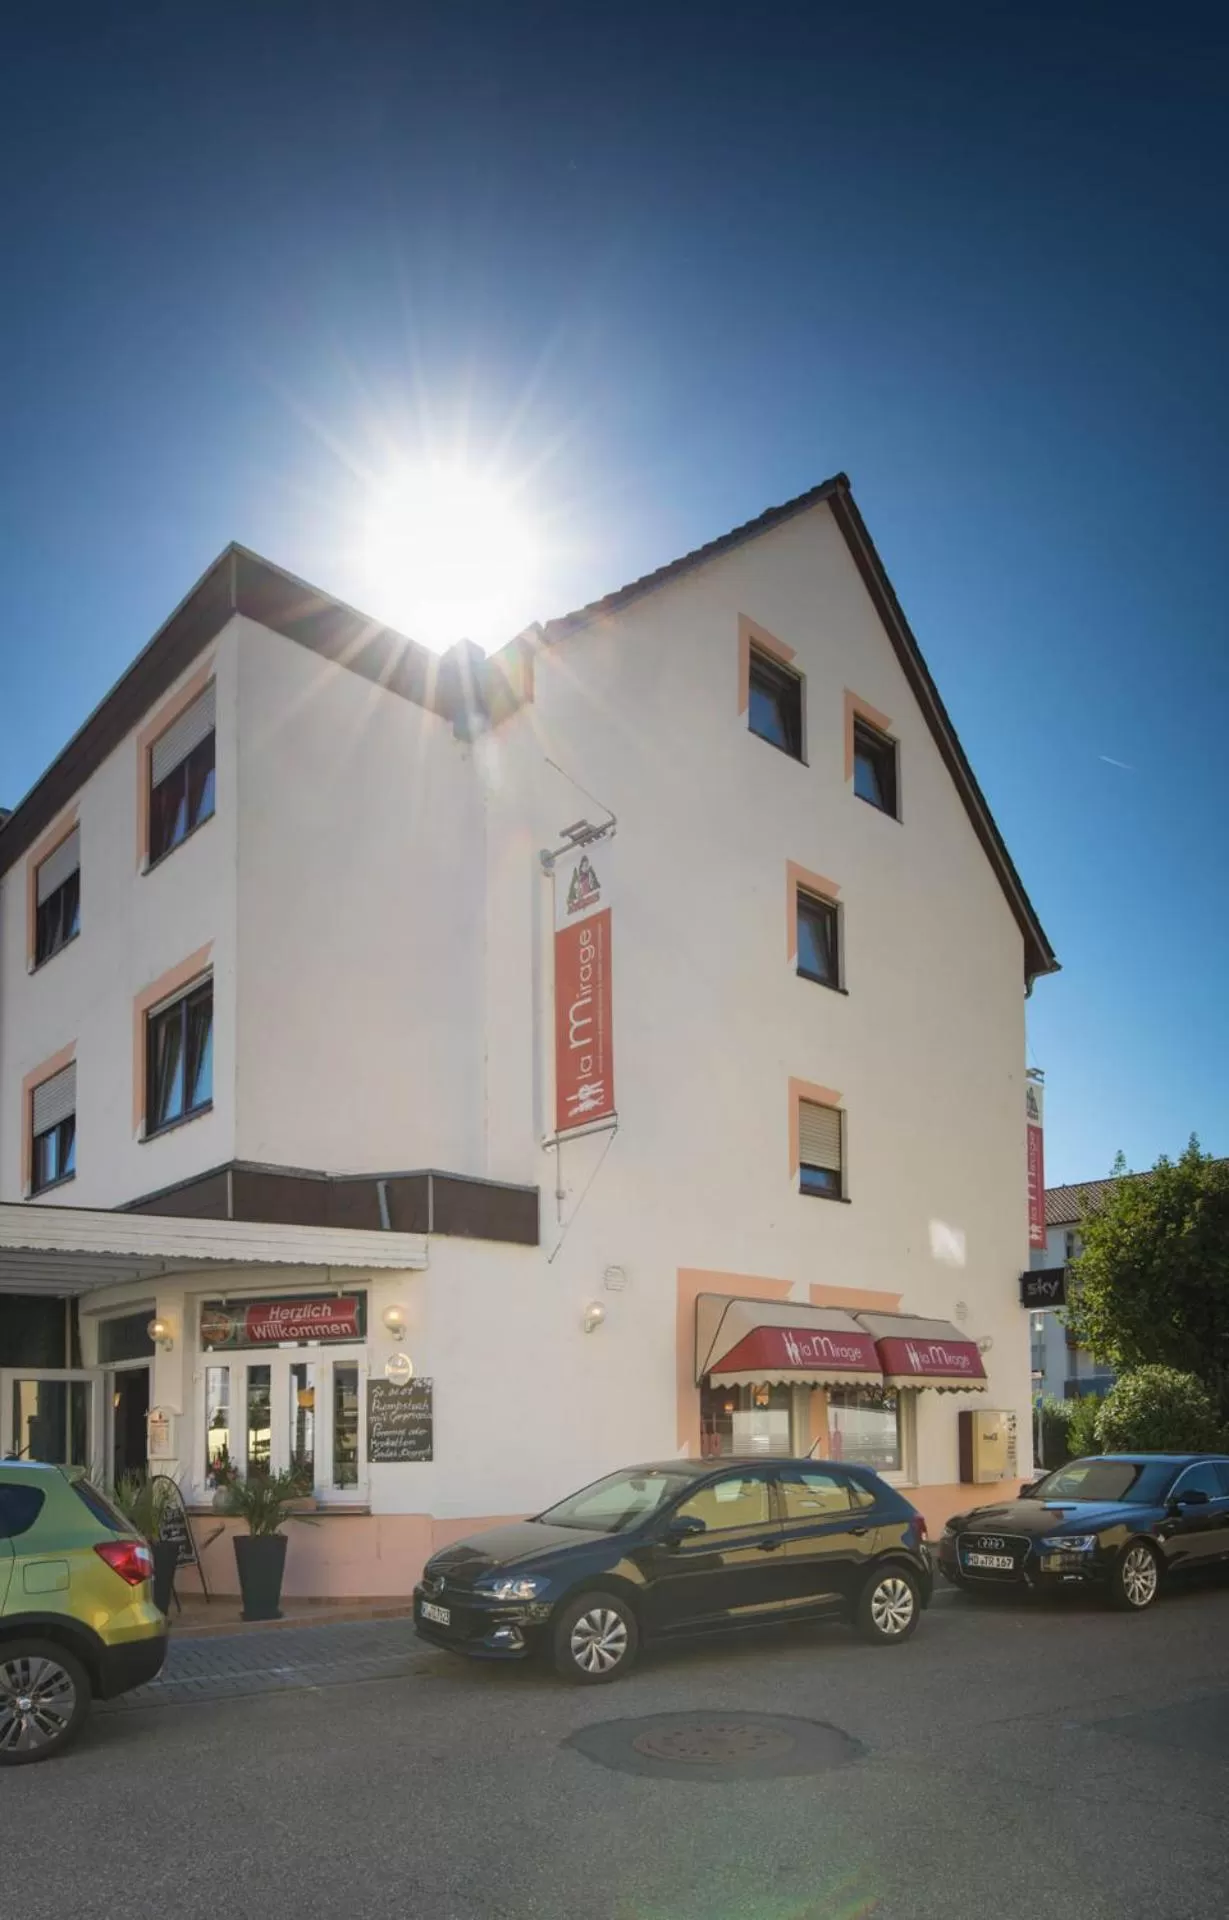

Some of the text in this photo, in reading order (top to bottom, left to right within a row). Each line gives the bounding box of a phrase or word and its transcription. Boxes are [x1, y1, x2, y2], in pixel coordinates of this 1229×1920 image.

[576, 1055, 593, 1080] la
[1026, 1278, 1060, 1299] sky
[268, 1303, 332, 1321] Herzlich
[251, 1322, 352, 1340] Willkommen
[799, 1341, 812, 1357] la
